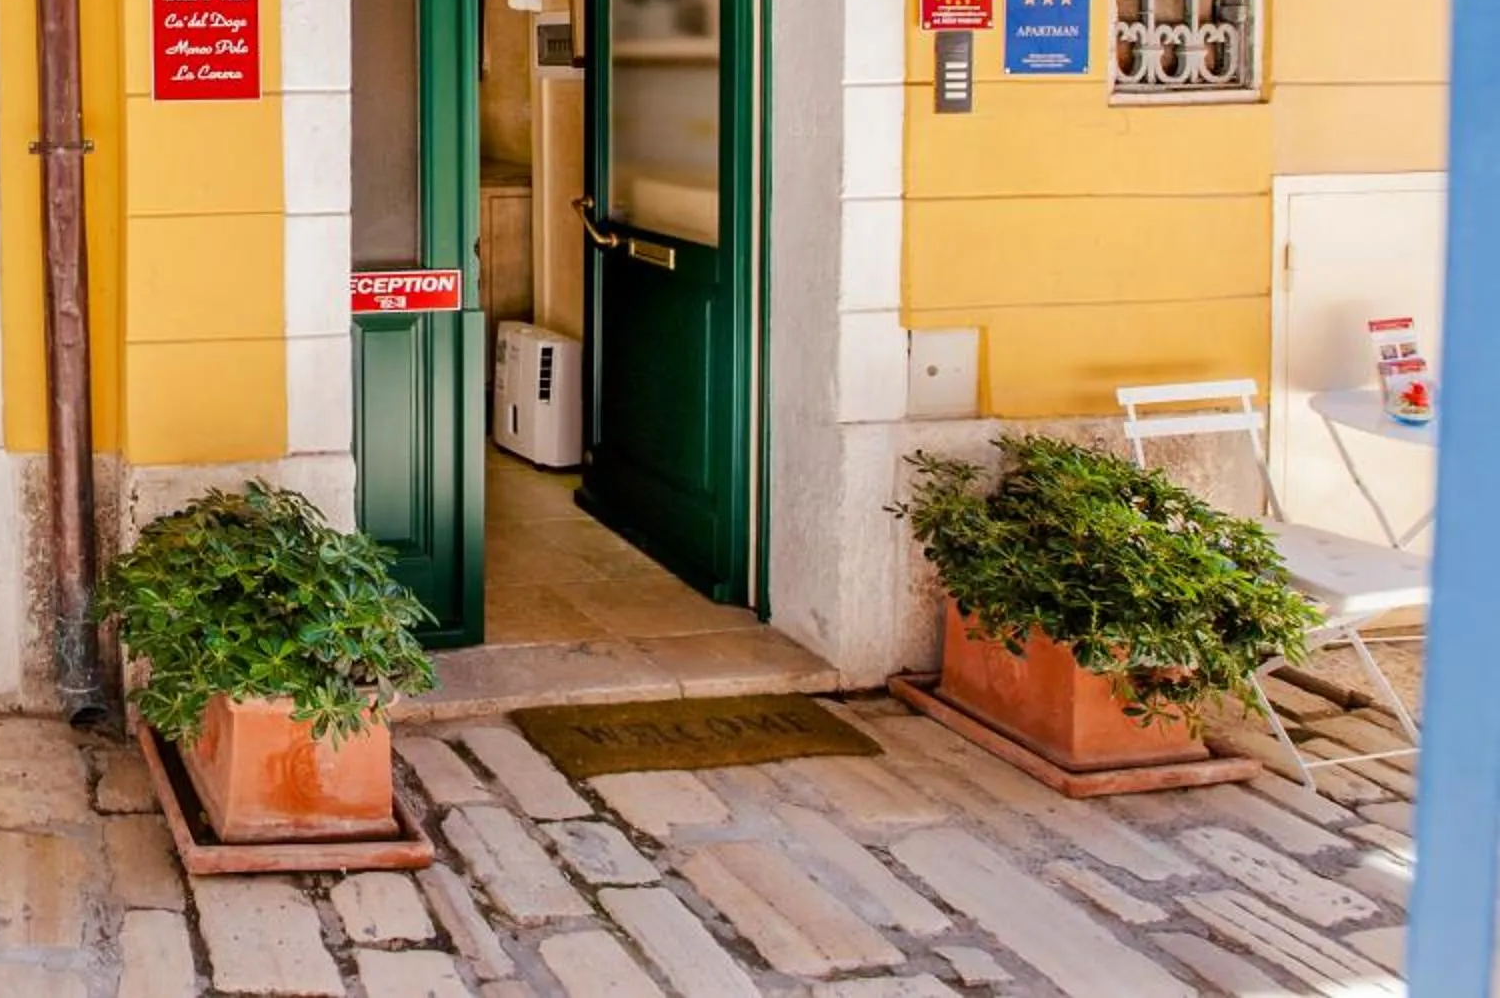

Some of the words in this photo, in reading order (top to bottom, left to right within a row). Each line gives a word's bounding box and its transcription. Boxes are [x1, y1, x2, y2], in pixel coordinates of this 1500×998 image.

[1016, 25, 1080, 38] APARTMAN
[214, 38, 250, 55] Polo
[349, 275, 455, 294] ECEPTION
